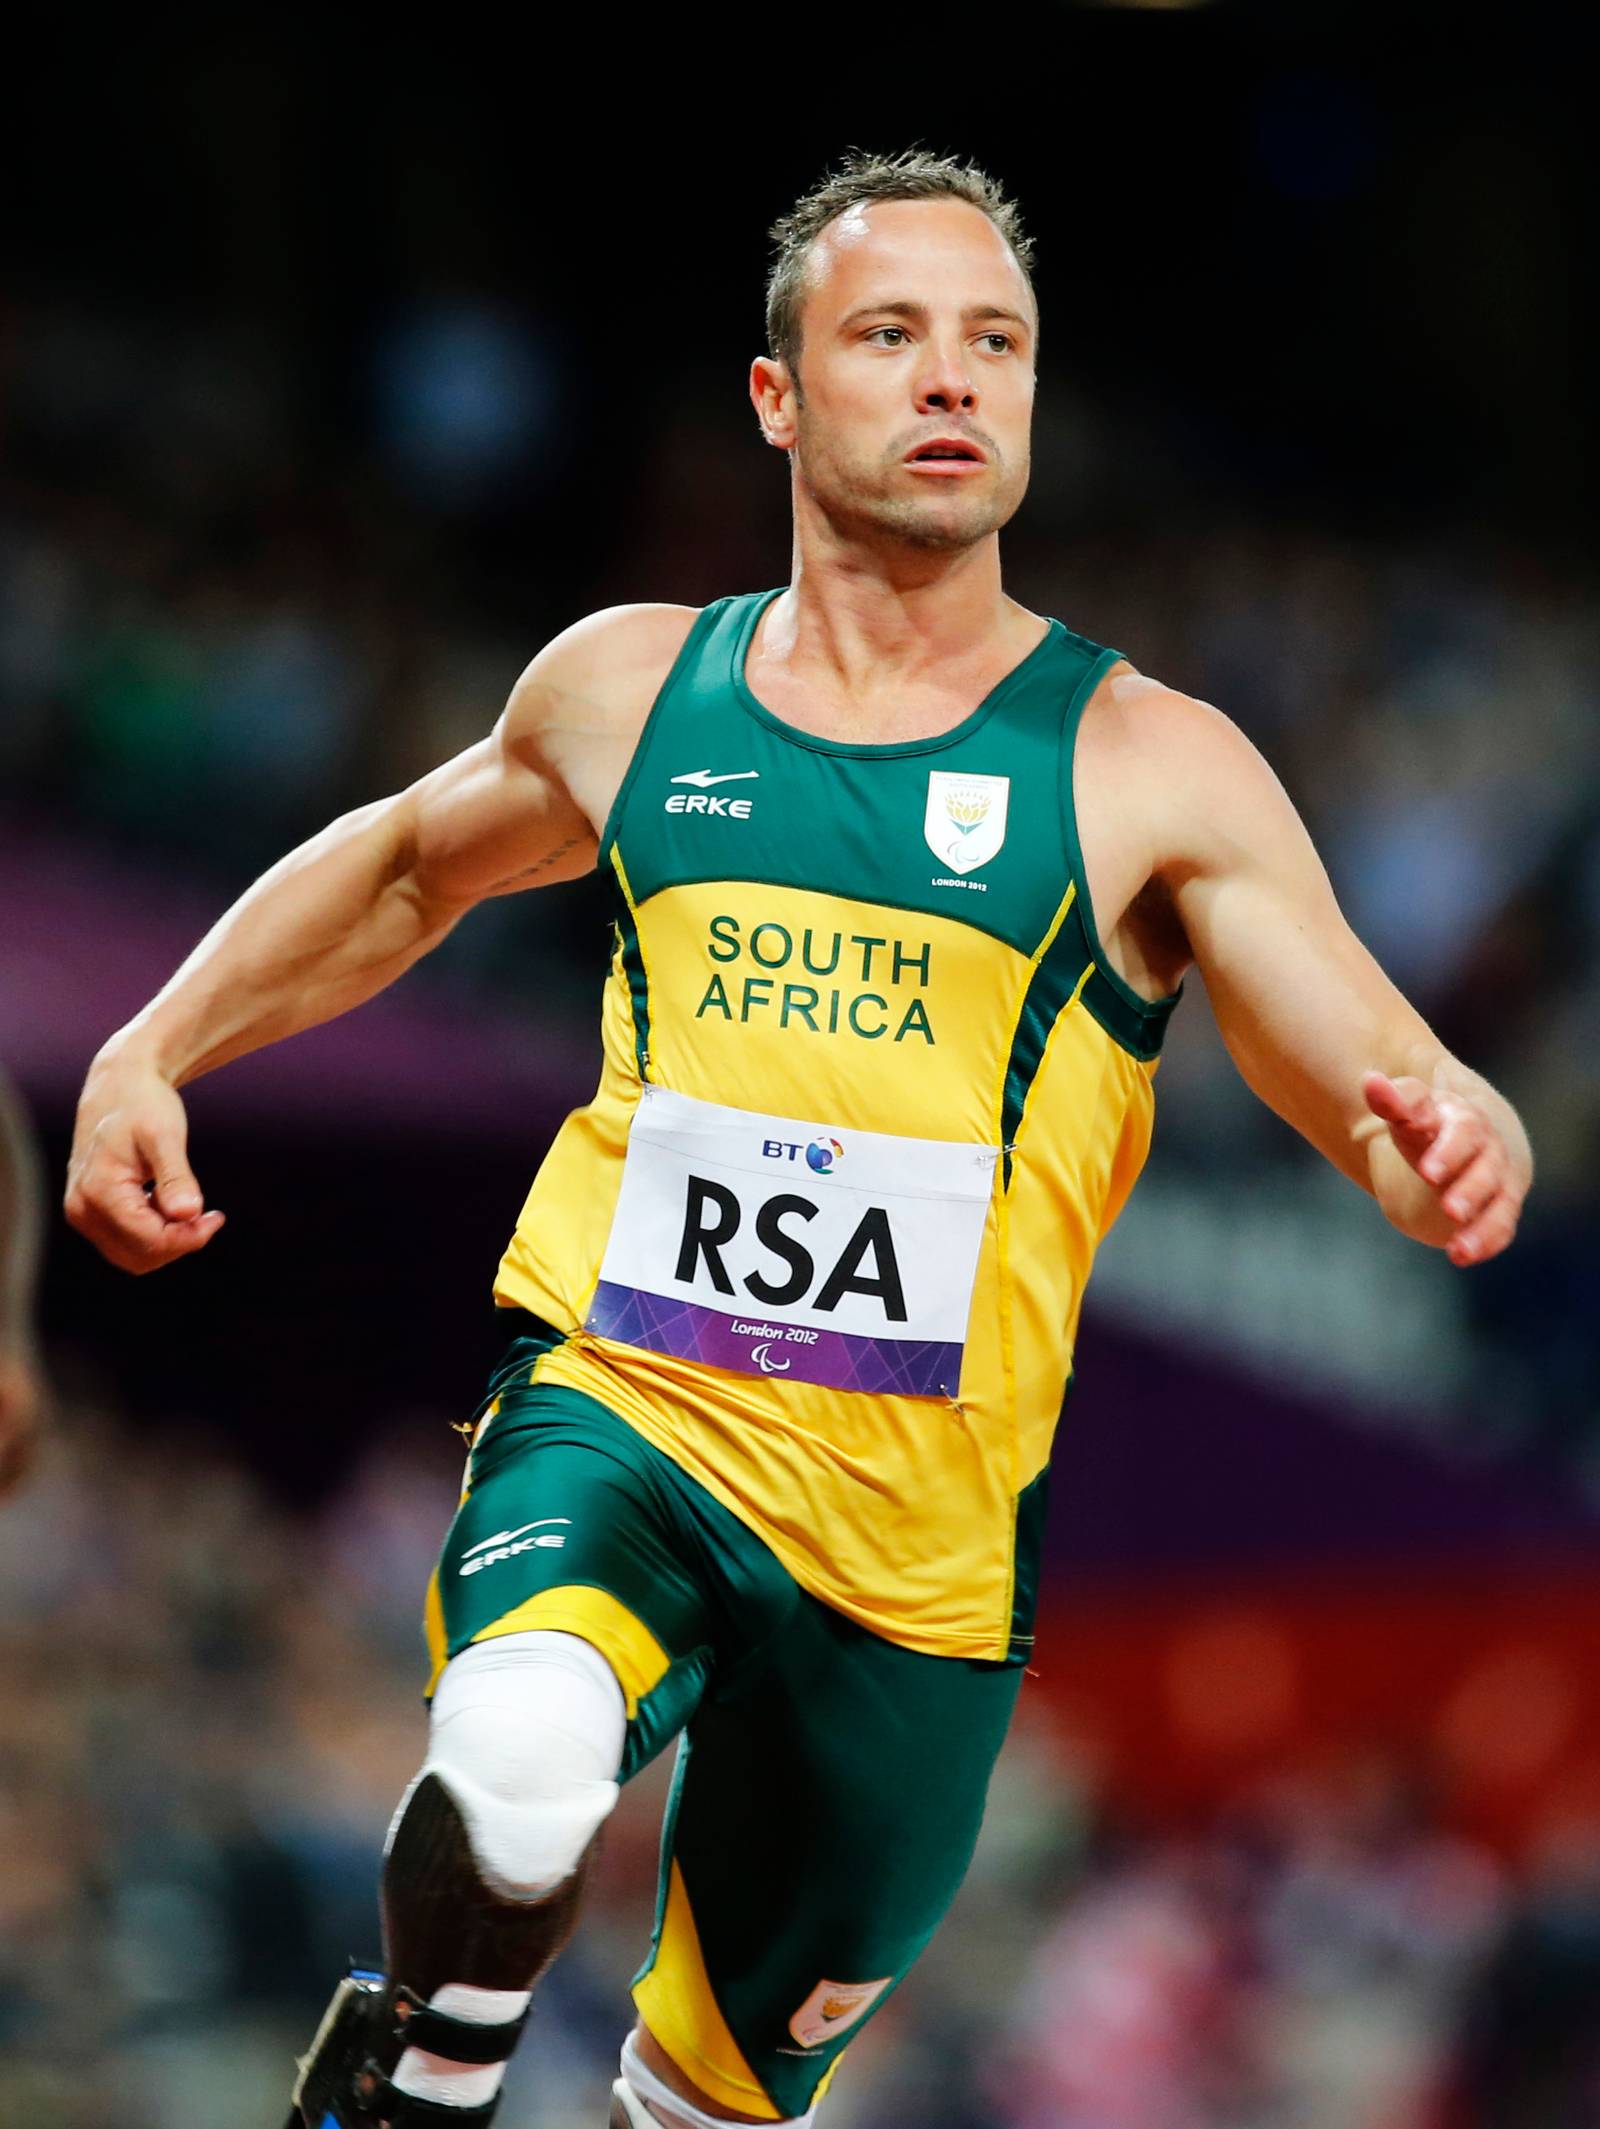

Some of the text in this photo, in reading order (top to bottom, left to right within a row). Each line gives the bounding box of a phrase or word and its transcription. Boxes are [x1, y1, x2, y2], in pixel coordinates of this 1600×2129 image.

[665, 795, 753, 819] ERKE
[931, 878, 968, 888] LONDON
[707, 915, 931, 987] SOUTH
[696, 973, 936, 1045] AFRICA
[762, 1140, 803, 1161] BT
[675, 1174, 908, 1322] RSA
[730, 1319, 819, 1345] London 2012
